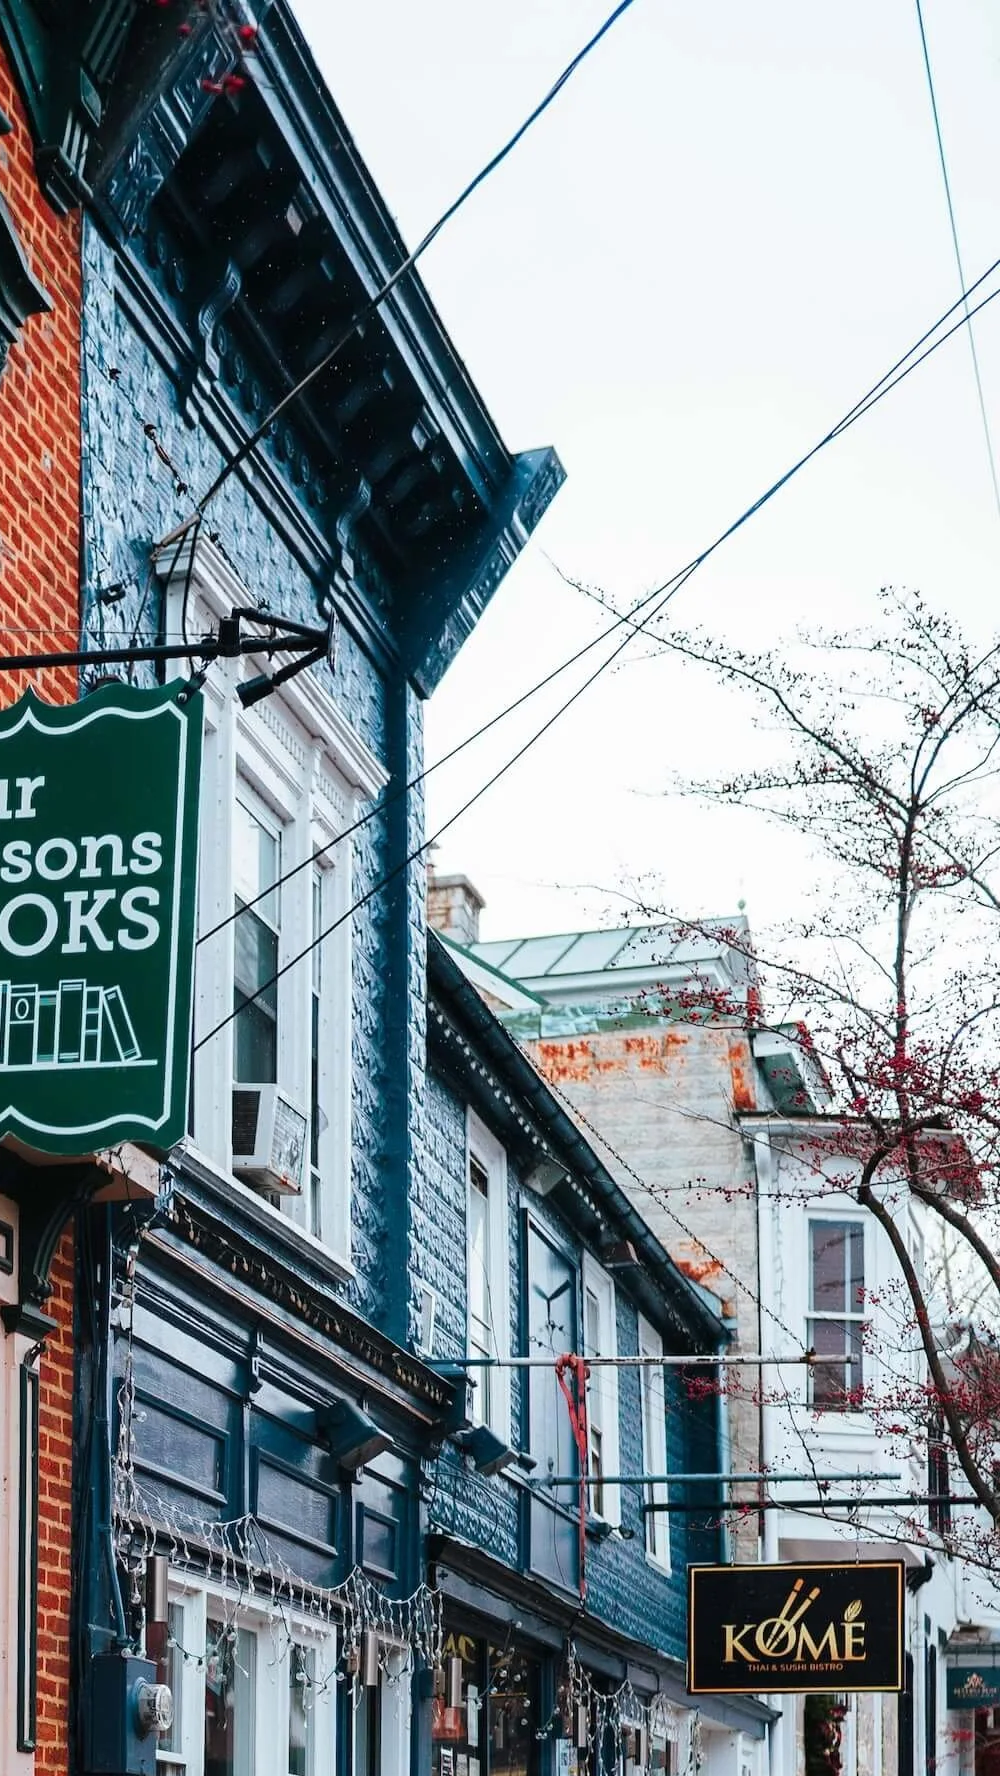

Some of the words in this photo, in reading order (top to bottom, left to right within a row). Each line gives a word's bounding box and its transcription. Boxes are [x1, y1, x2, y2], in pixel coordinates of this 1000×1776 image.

[748, 1664, 770, 1672] THAI
[771, 1664, 778, 1672] &
[780, 1663, 808, 1672] SUSHI
[810, 1663, 845, 1672] BISTRO
